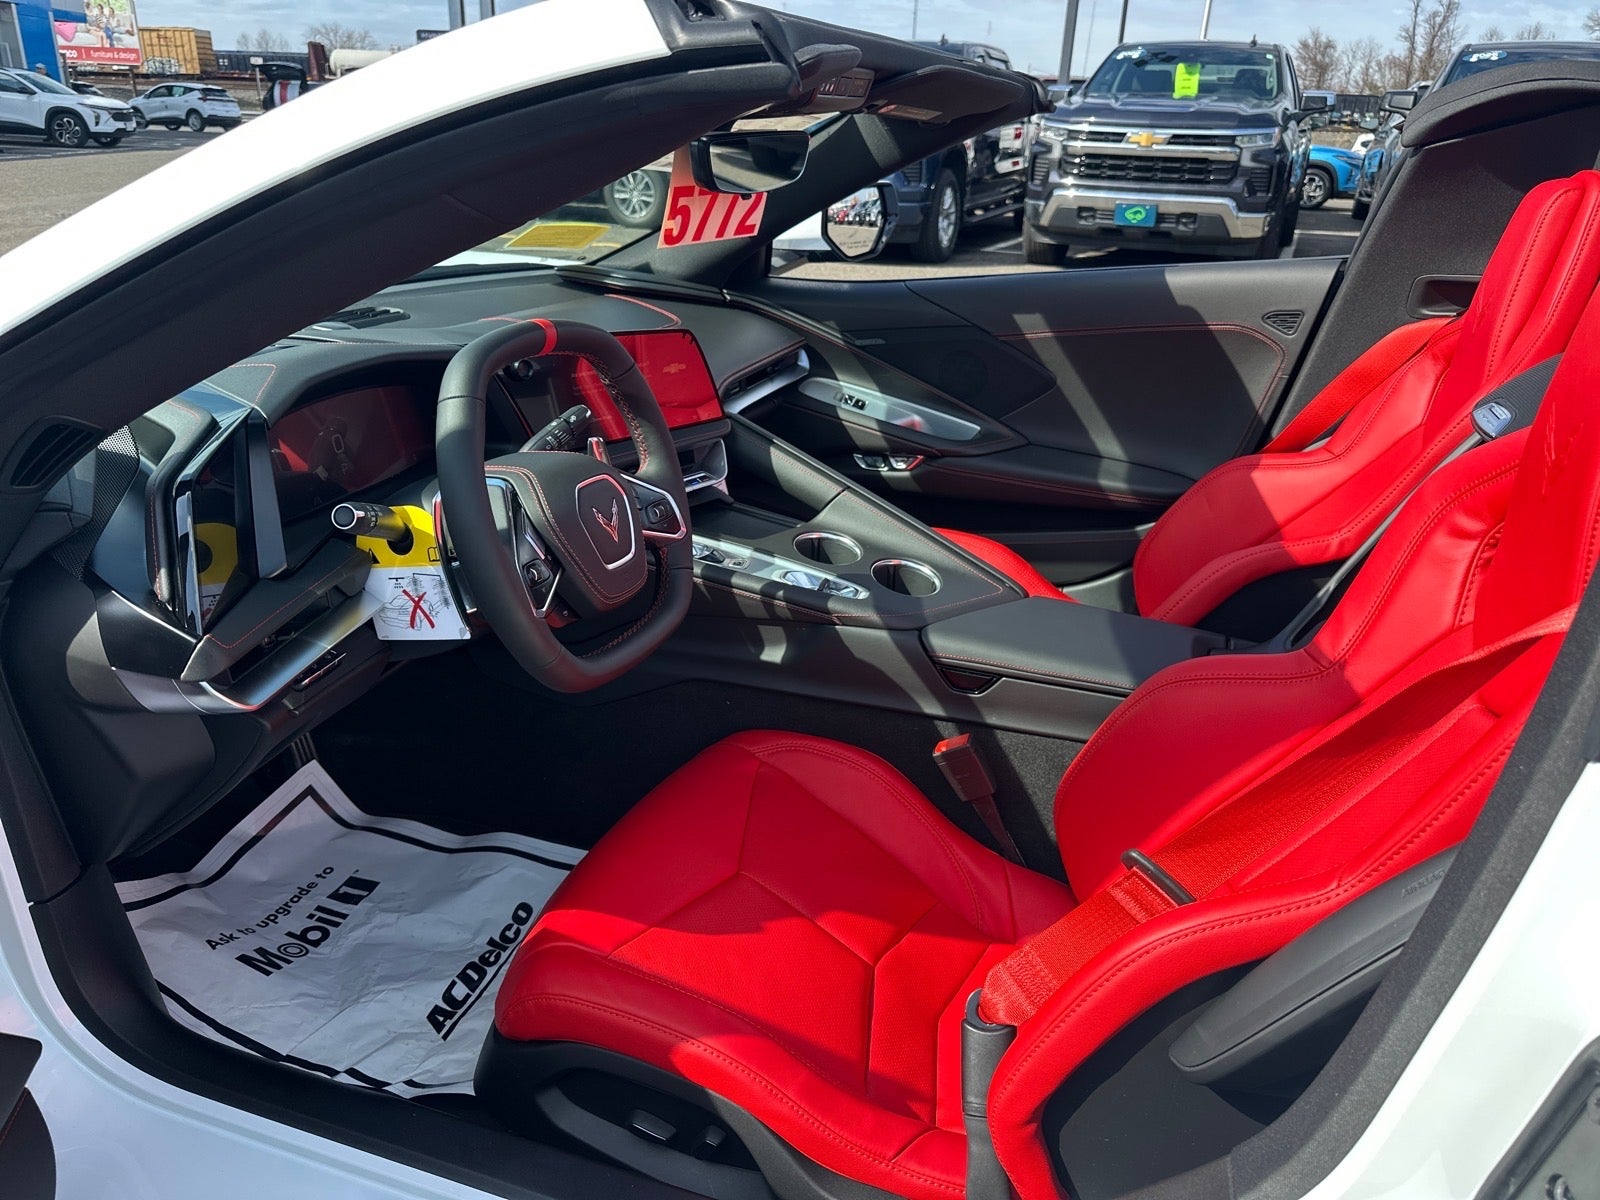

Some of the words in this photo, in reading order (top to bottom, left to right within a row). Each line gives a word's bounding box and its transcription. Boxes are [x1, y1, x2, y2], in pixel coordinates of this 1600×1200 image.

[119, 51, 137, 61] design
[205, 932, 240, 950] Ask
[237, 927, 256, 935] to
[256, 881, 318, 929] upgrade
[315, 866, 334, 879] to
[235, 905, 350, 977] Mobil
[426, 902, 533, 1035] ACDelco
